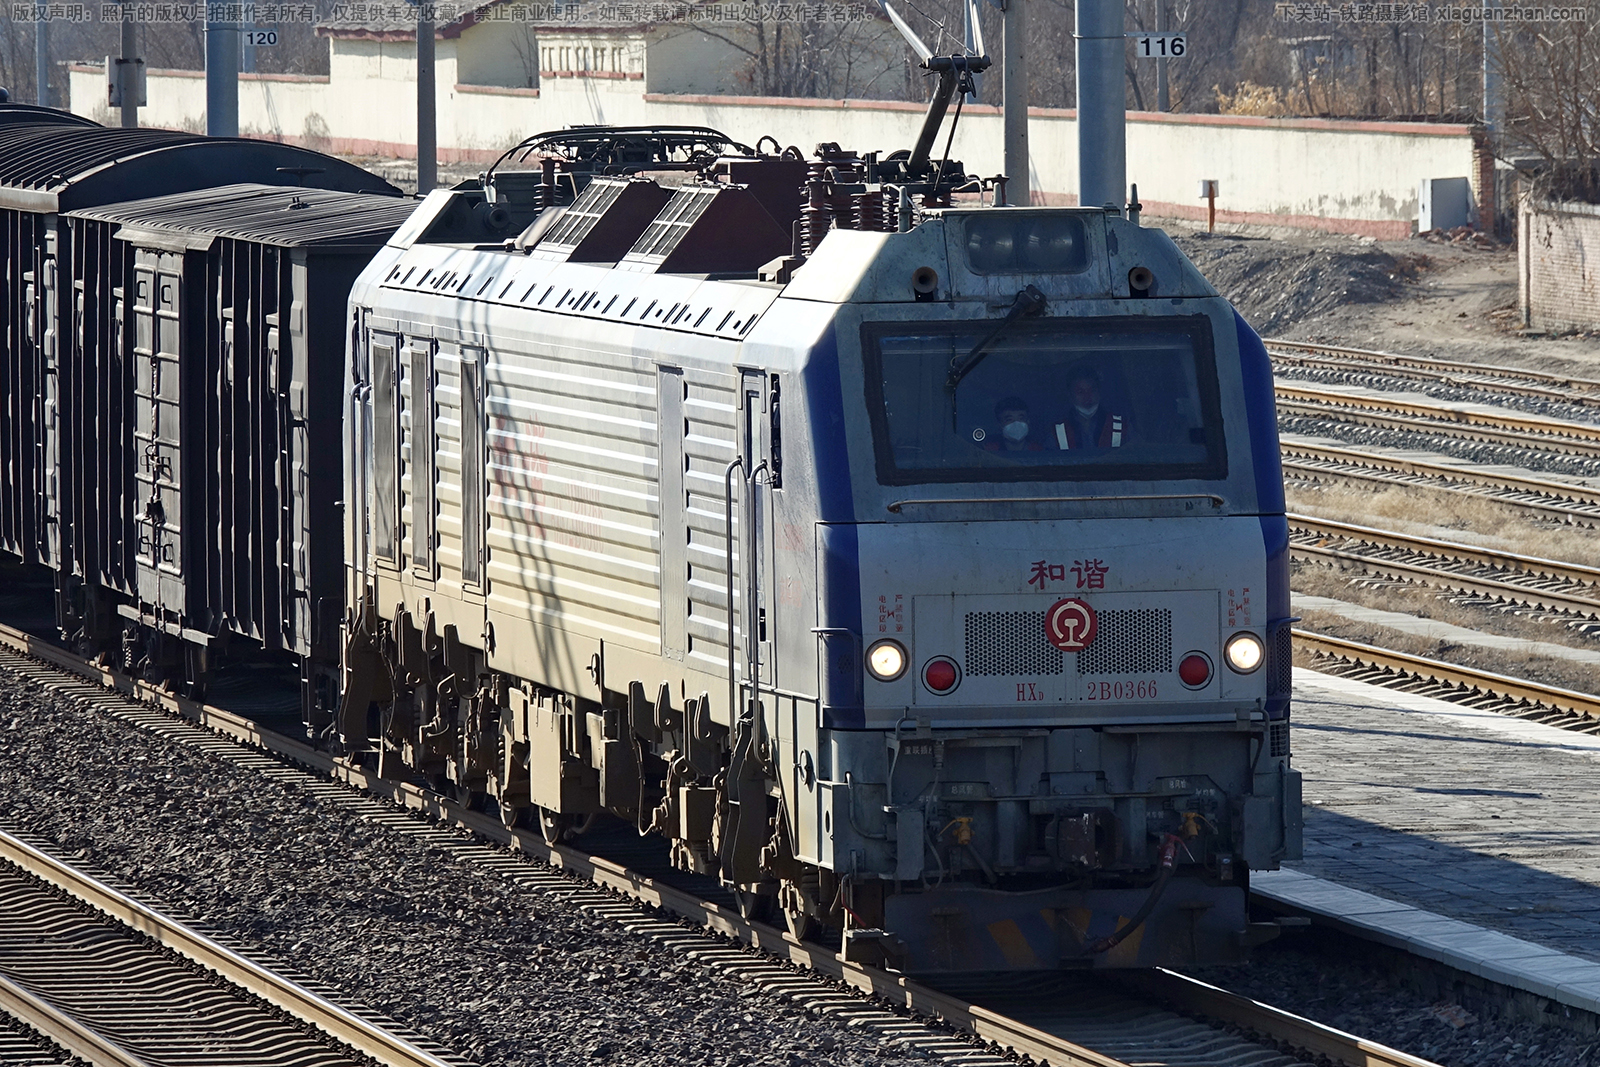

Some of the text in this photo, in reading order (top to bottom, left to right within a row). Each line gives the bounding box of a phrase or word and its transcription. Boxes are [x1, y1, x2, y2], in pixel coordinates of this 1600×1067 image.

[247, 32, 277, 45] 120
[1141, 37, 1185, 56] 116
[1028, 558, 1109, 590] 和谐
[1087, 679, 1157, 700] 2B0366
